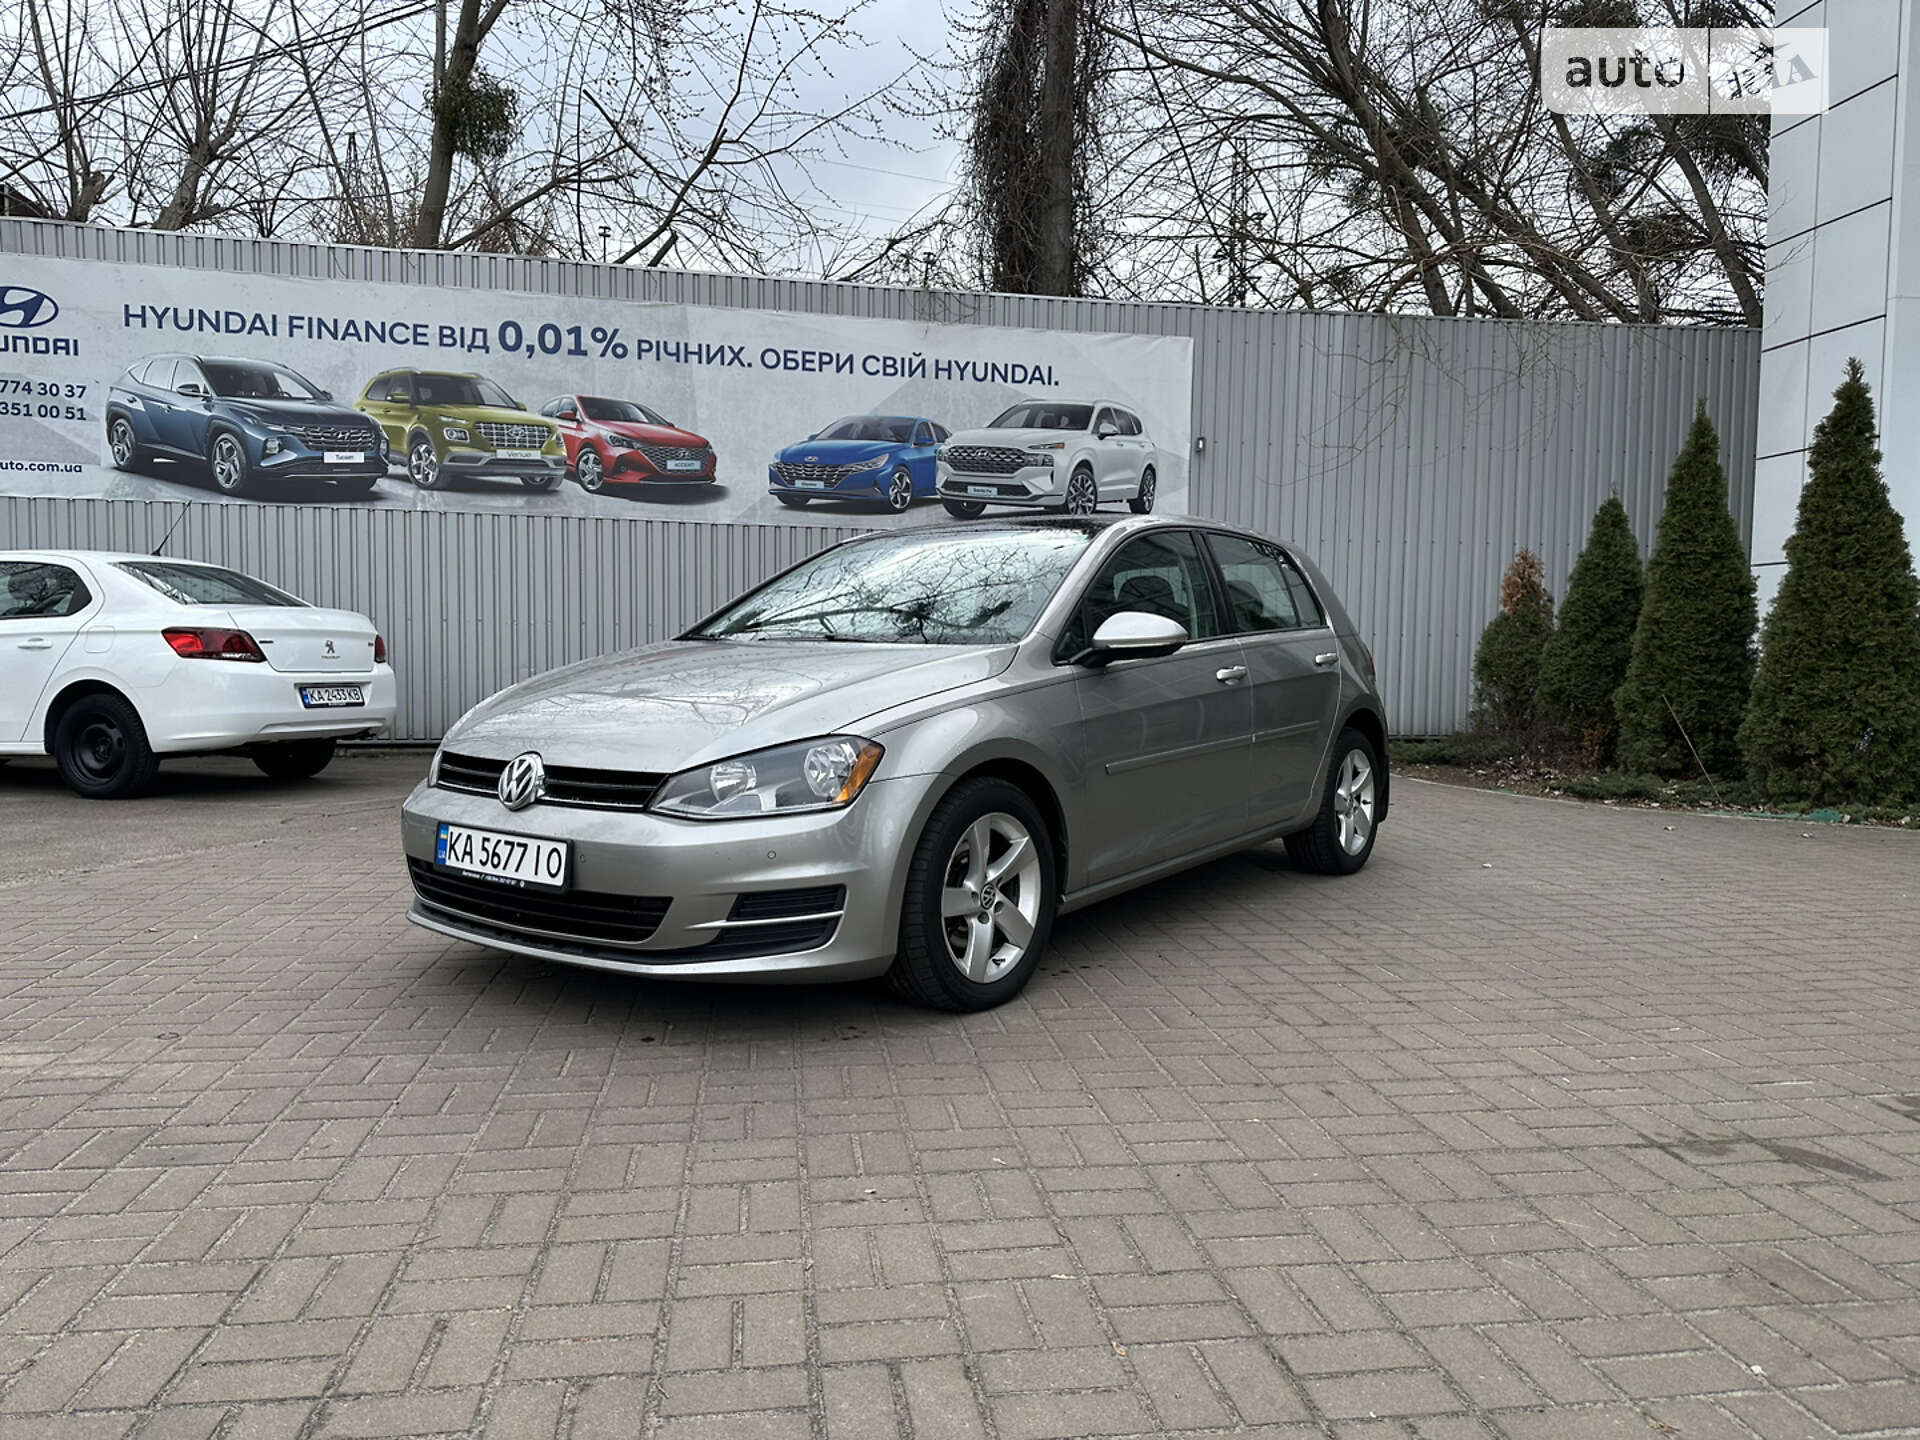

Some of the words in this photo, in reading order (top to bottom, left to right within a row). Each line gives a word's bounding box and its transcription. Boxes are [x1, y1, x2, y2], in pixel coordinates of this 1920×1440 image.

[123, 304, 278, 337] HYUNDAI
[288, 315, 430, 346] FINANCE
[438, 325, 490, 354] ВІД
[498, 320, 629, 359] 0,01%
[636, 339, 753, 368] РІЧНИХ.
[760, 348, 854, 375] ОБЕРИ
[861, 352, 926, 379] СВІЙ
[934, 359, 1060, 387] HYUNDAI.
[37, 382, 60, 397] 30
[64, 384, 87, 399] 37
[0, 401, 33, 417] 351
[37, 404, 60, 419] 00
[64, 406, 87, 421] 51
[309, 687, 325, 702] KA
[447, 831, 473, 865] KA
[479, 837, 529, 873] 5677
[534, 845, 563, 879] IO
